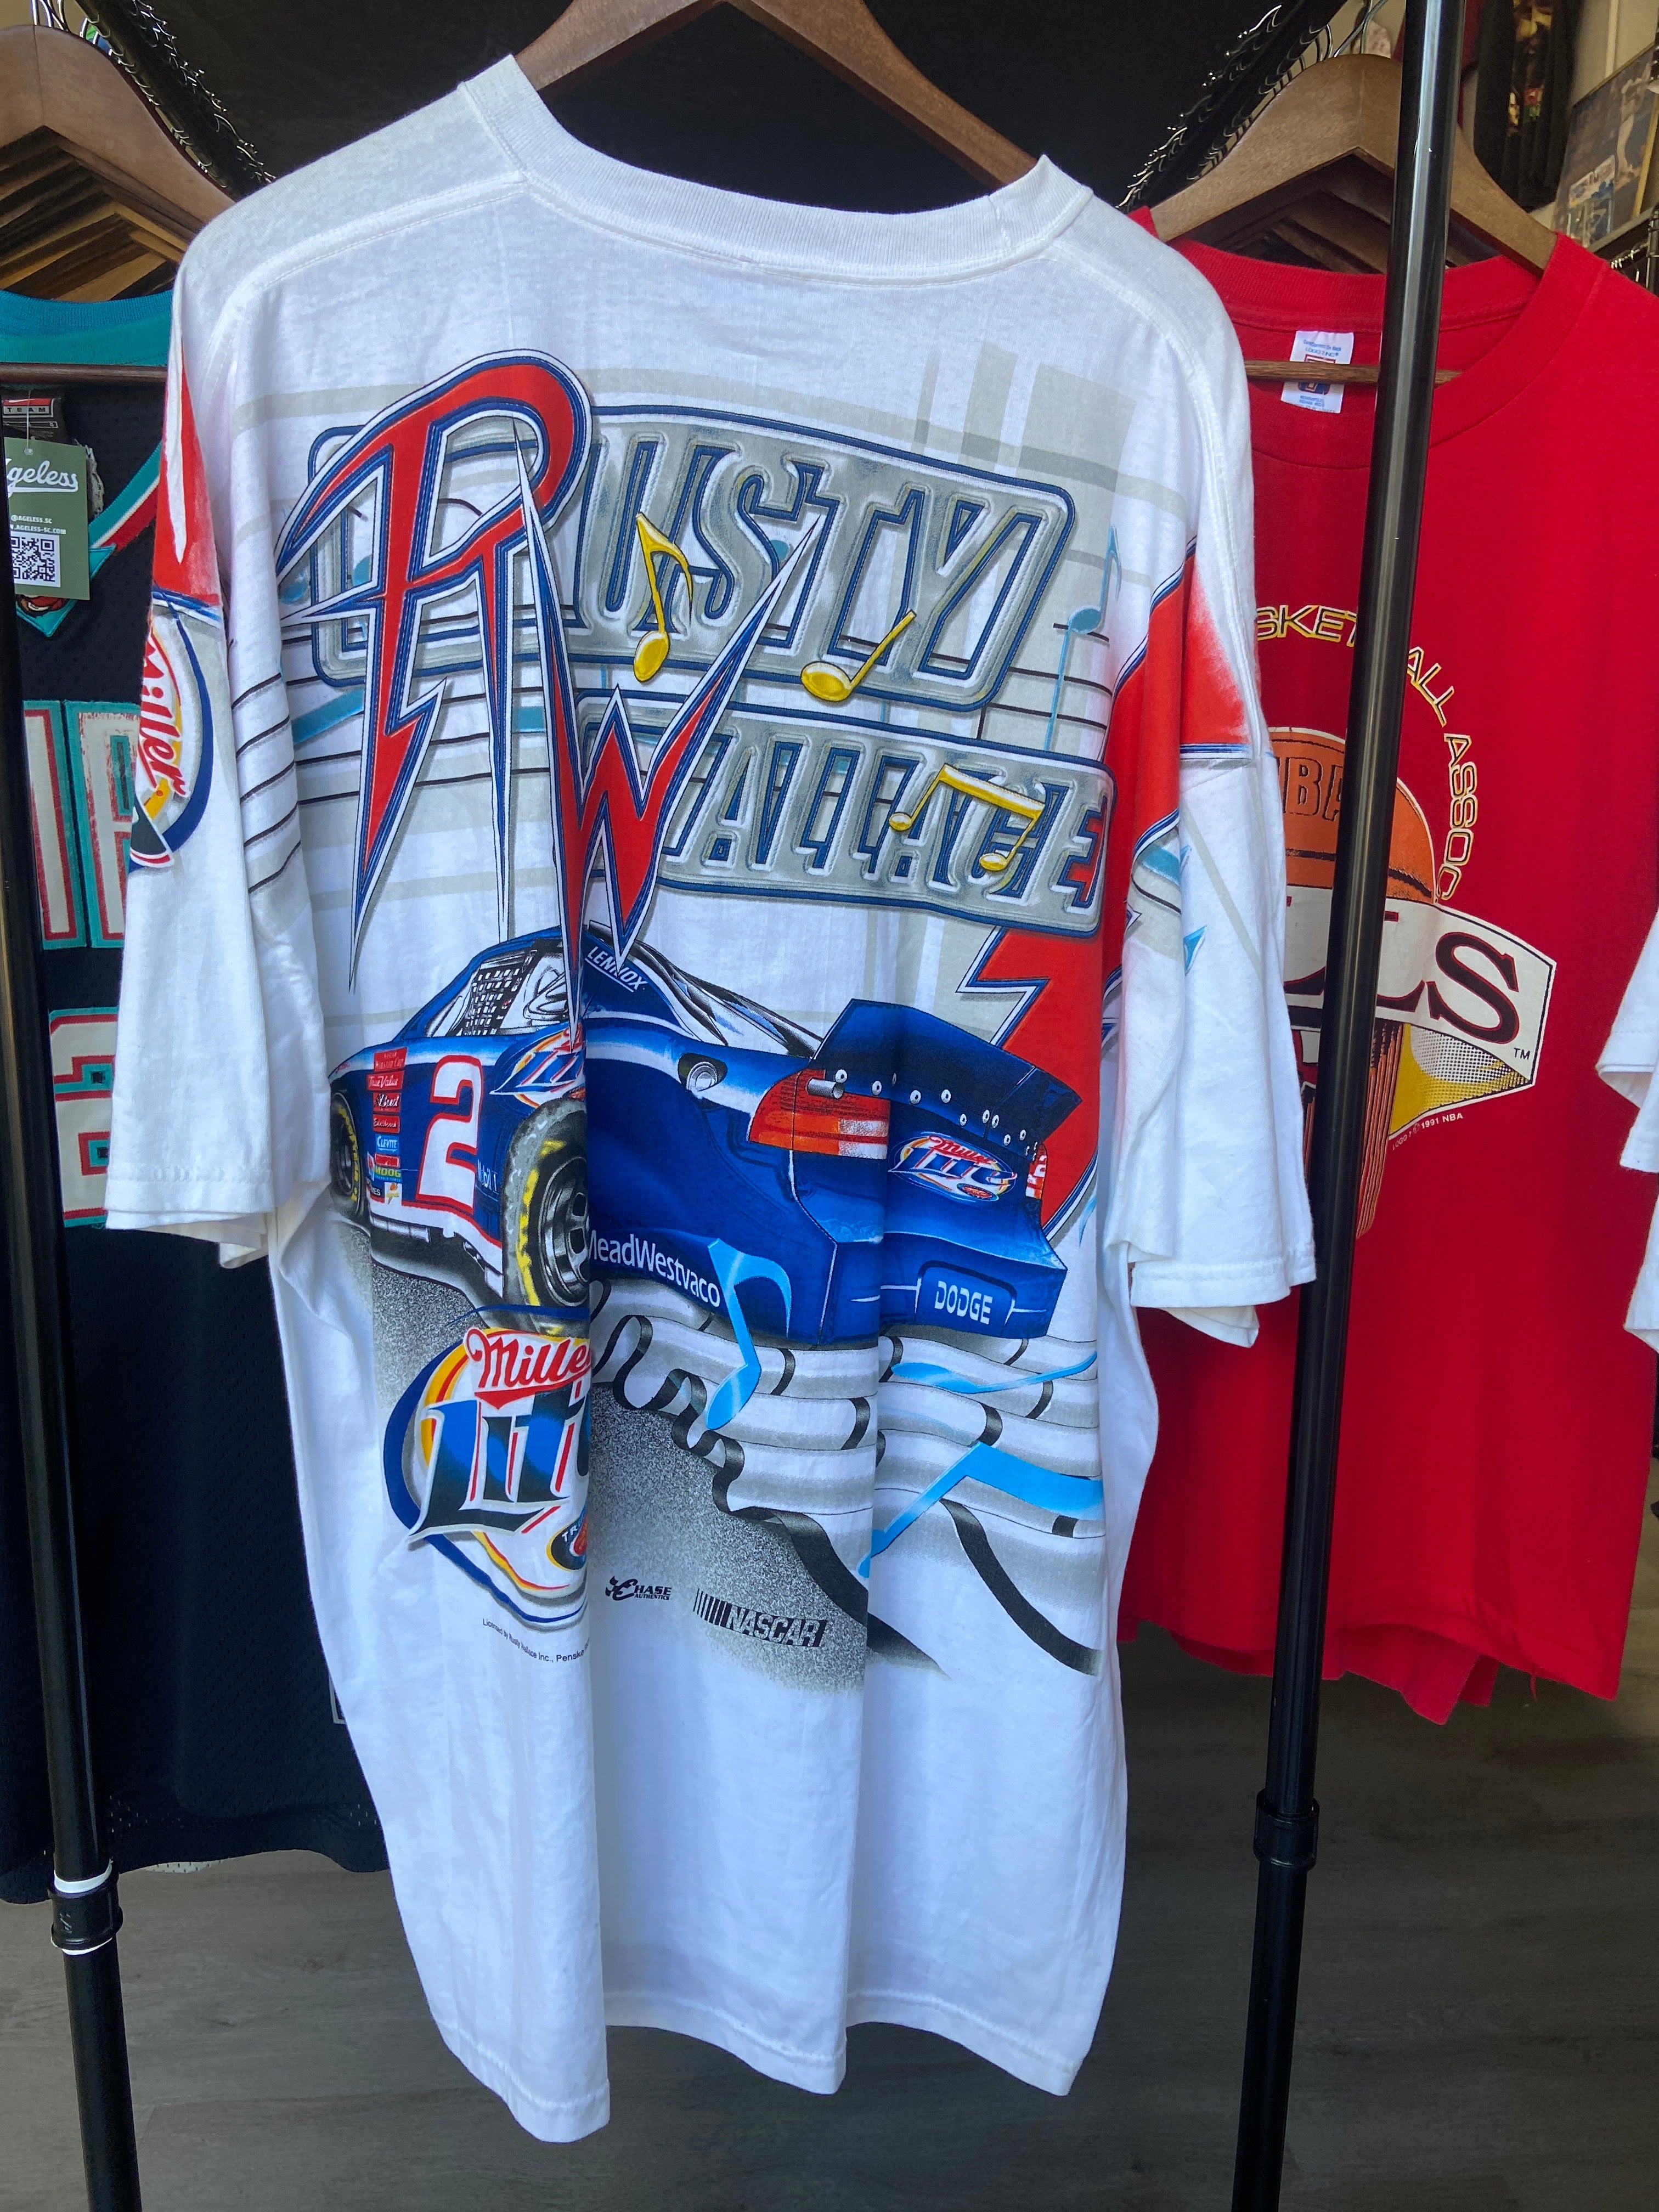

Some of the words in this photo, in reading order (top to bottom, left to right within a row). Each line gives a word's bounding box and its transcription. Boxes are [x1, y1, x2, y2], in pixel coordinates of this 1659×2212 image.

[5, 458, 78, 498] geless
[11, 515, 53, 524] @AGELESS.SC
[587, 946, 648, 990] LENNOX
[414, 1054, 483, 1214] 2
[1442, 1113, 1464, 1123] NBA
[375, 1166, 402, 1178] MOOG
[934, 1280, 993, 1325] DODGE
[465, 1327, 591, 1389] Mille
[605, 1576, 672, 1601] CHASE
[721, 1602, 823, 1647] NASCAR
